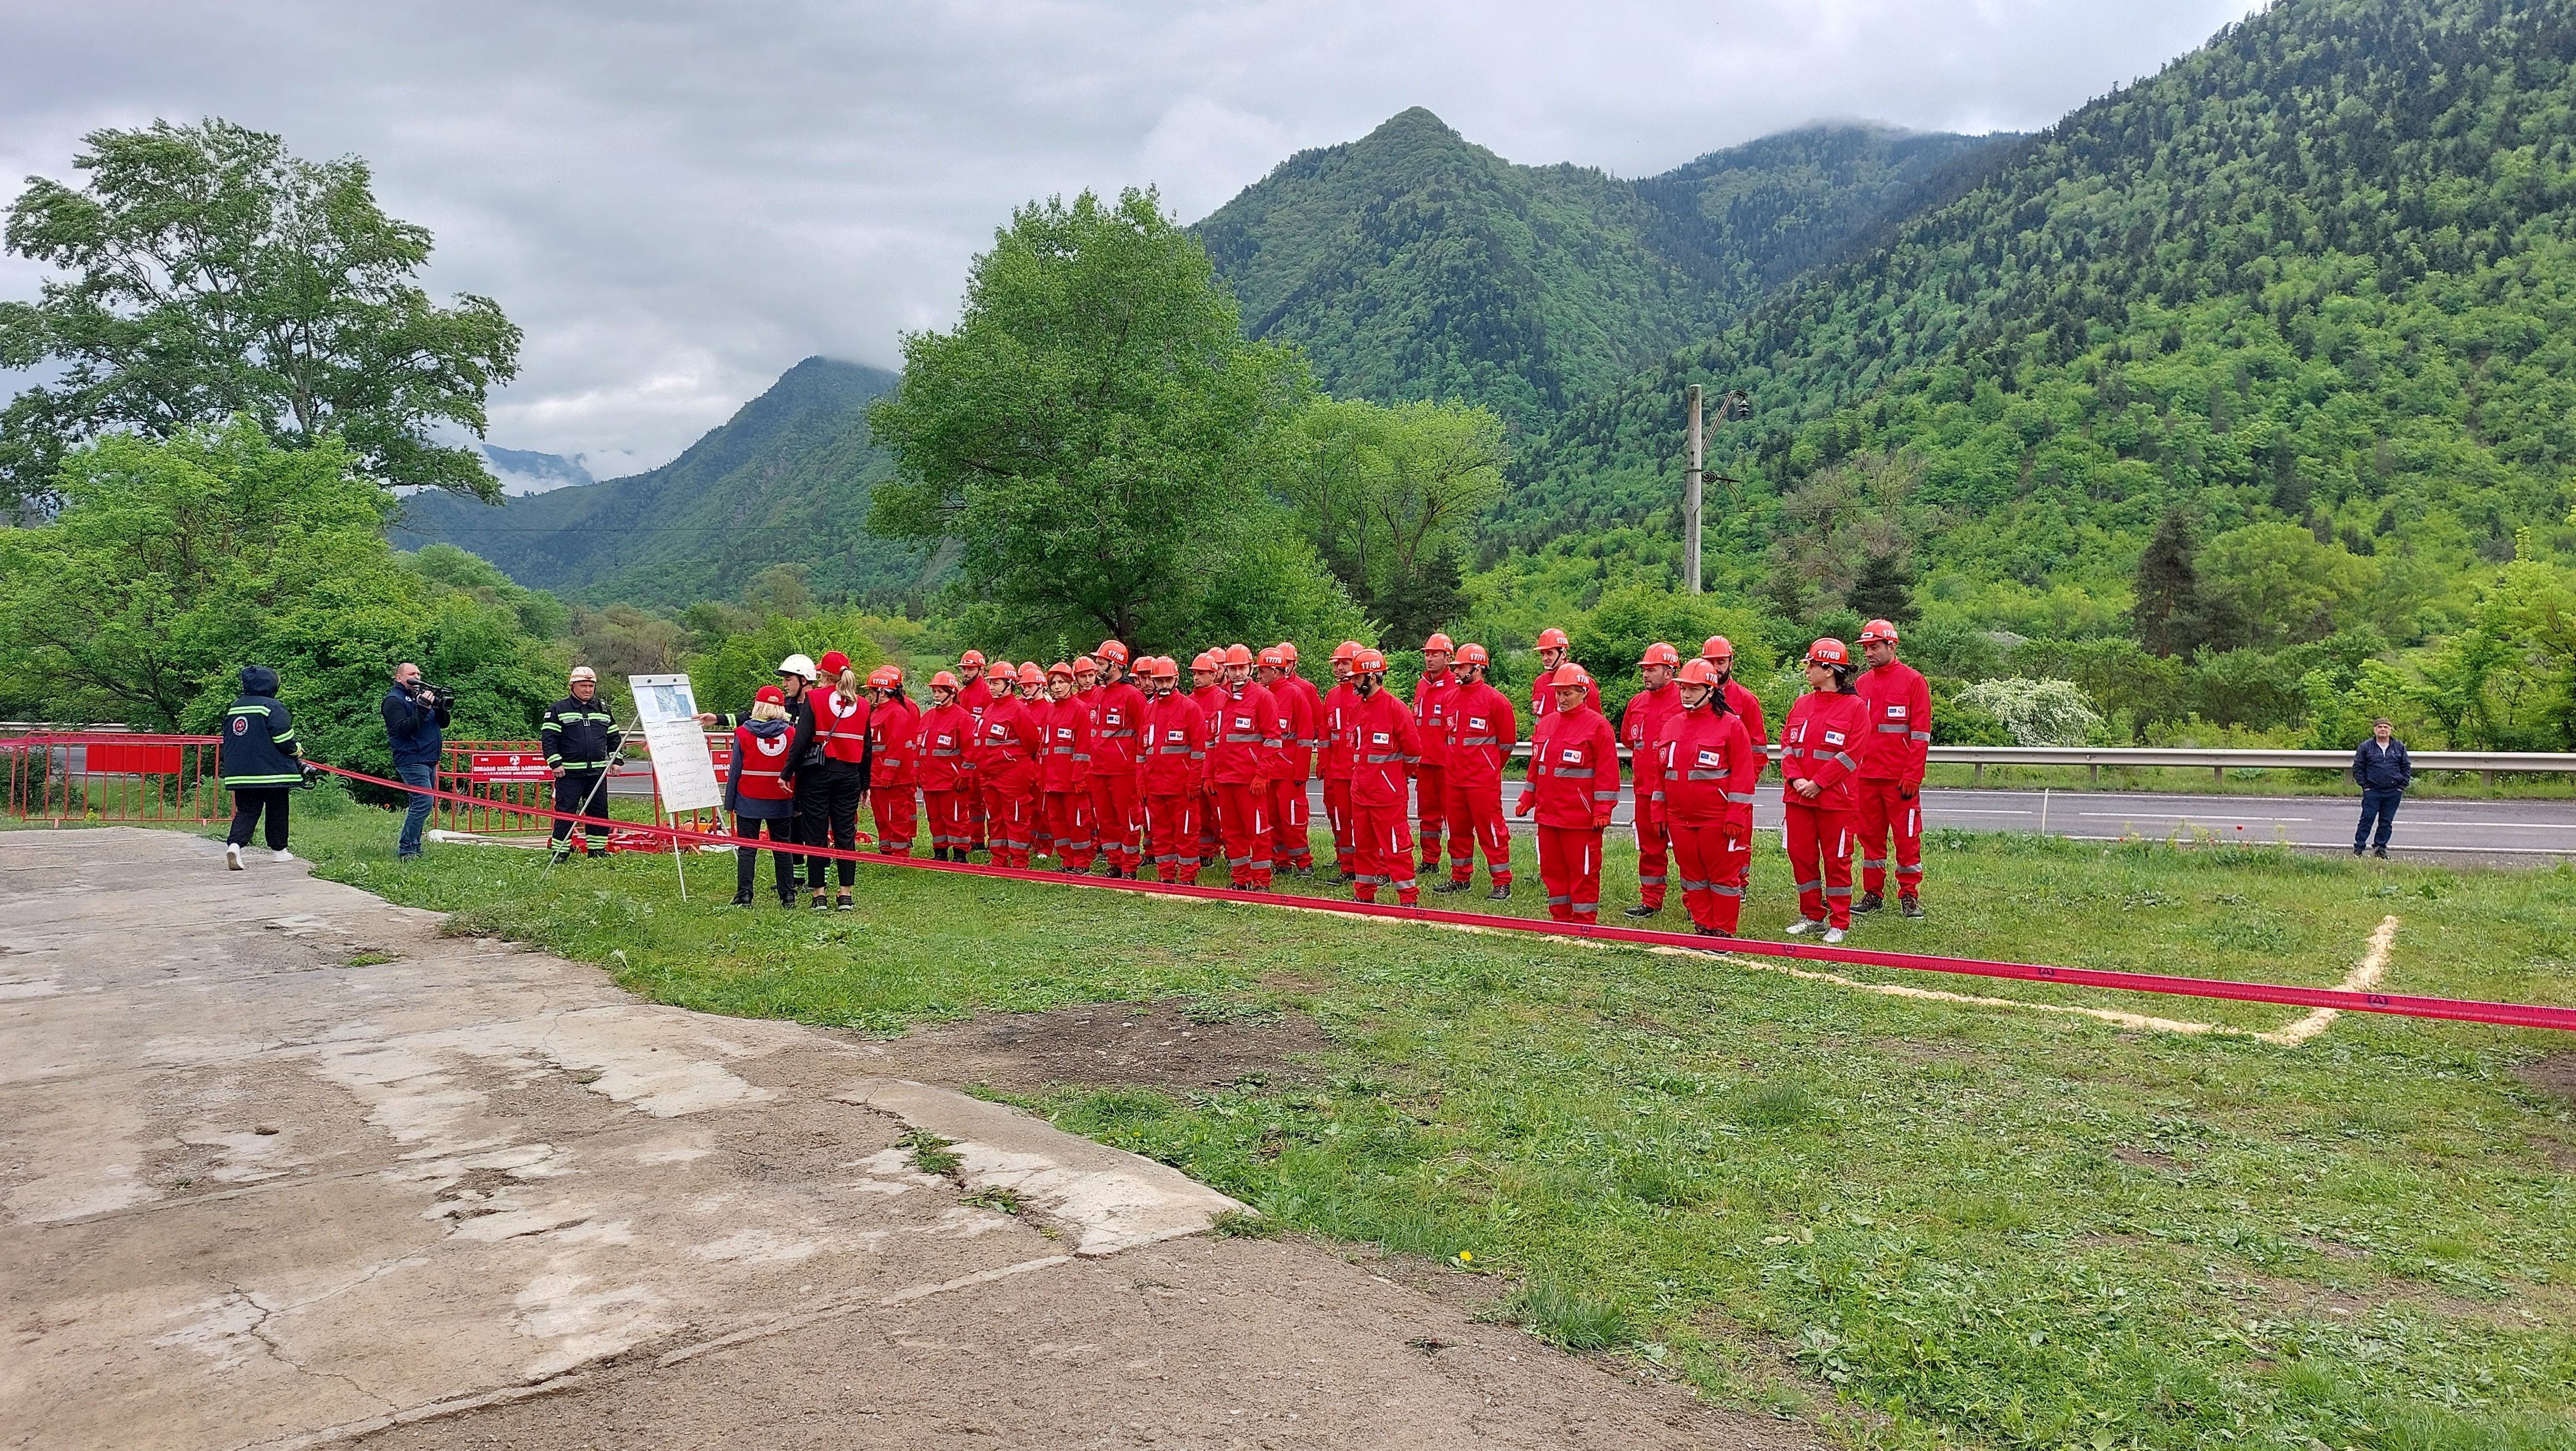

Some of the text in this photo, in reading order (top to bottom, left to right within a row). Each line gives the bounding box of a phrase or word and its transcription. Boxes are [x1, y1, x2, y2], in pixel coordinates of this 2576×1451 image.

[1470, 653, 1486, 661] 17/71
[1817, 650, 1840, 660] 17/69
[1361, 661, 1380, 670] 17/86
